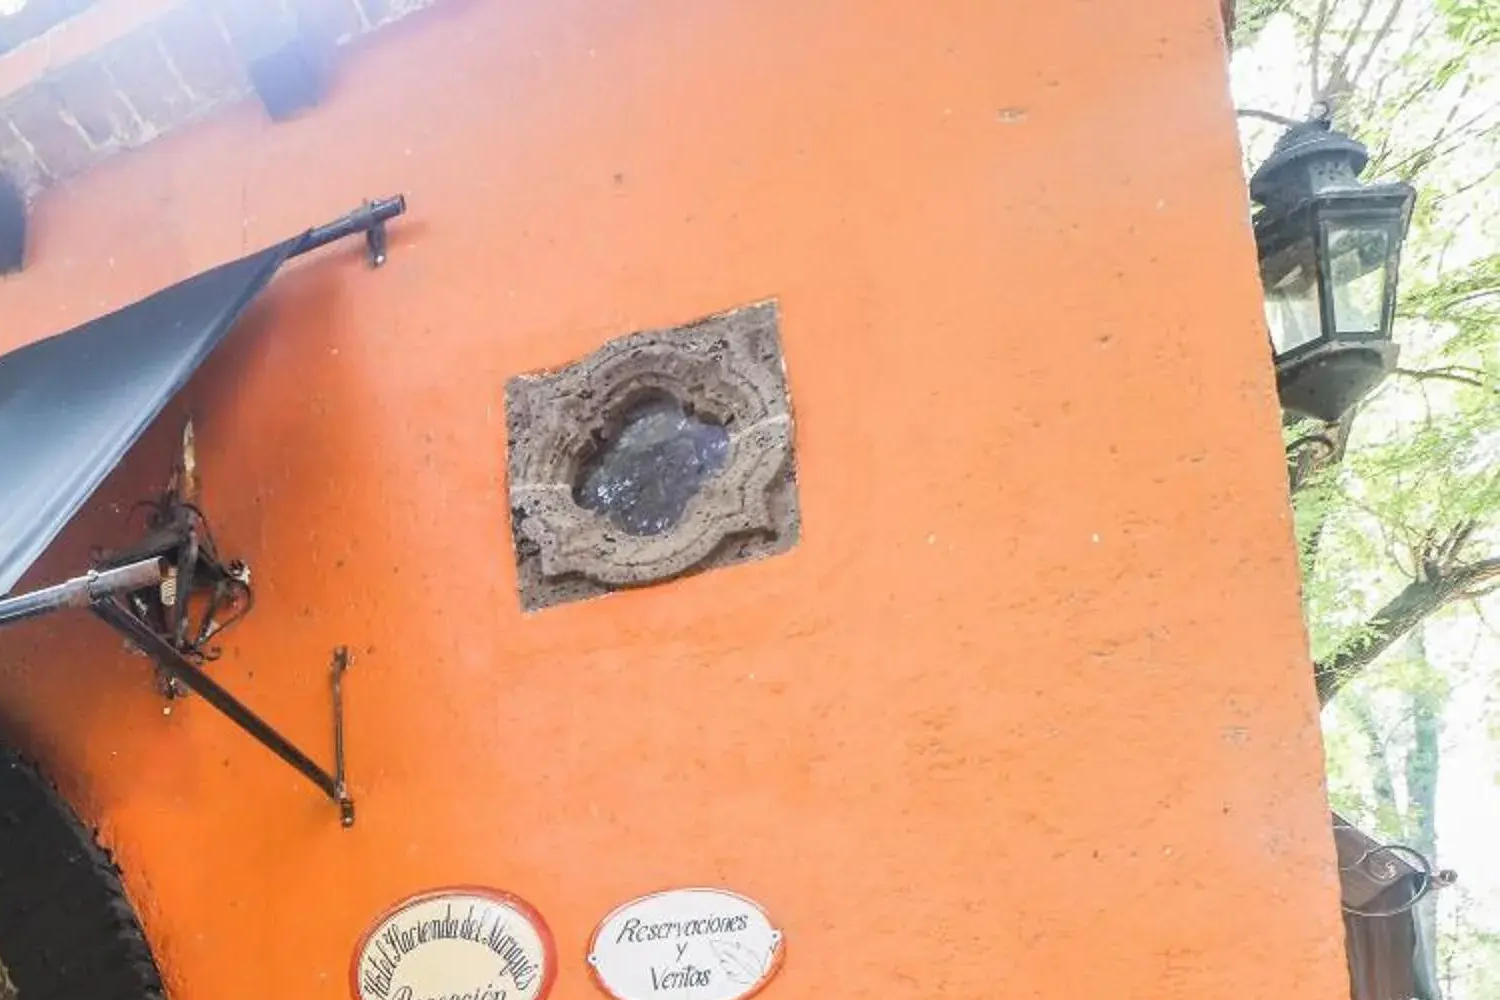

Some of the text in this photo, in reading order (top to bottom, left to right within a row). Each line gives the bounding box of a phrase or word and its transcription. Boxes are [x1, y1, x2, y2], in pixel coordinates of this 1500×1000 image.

[383, 904, 460, 962] Hacienda
[460, 904, 487, 943] del
[615, 913, 749, 945] Reservaciones
[650, 964, 712, 991] Ventas
